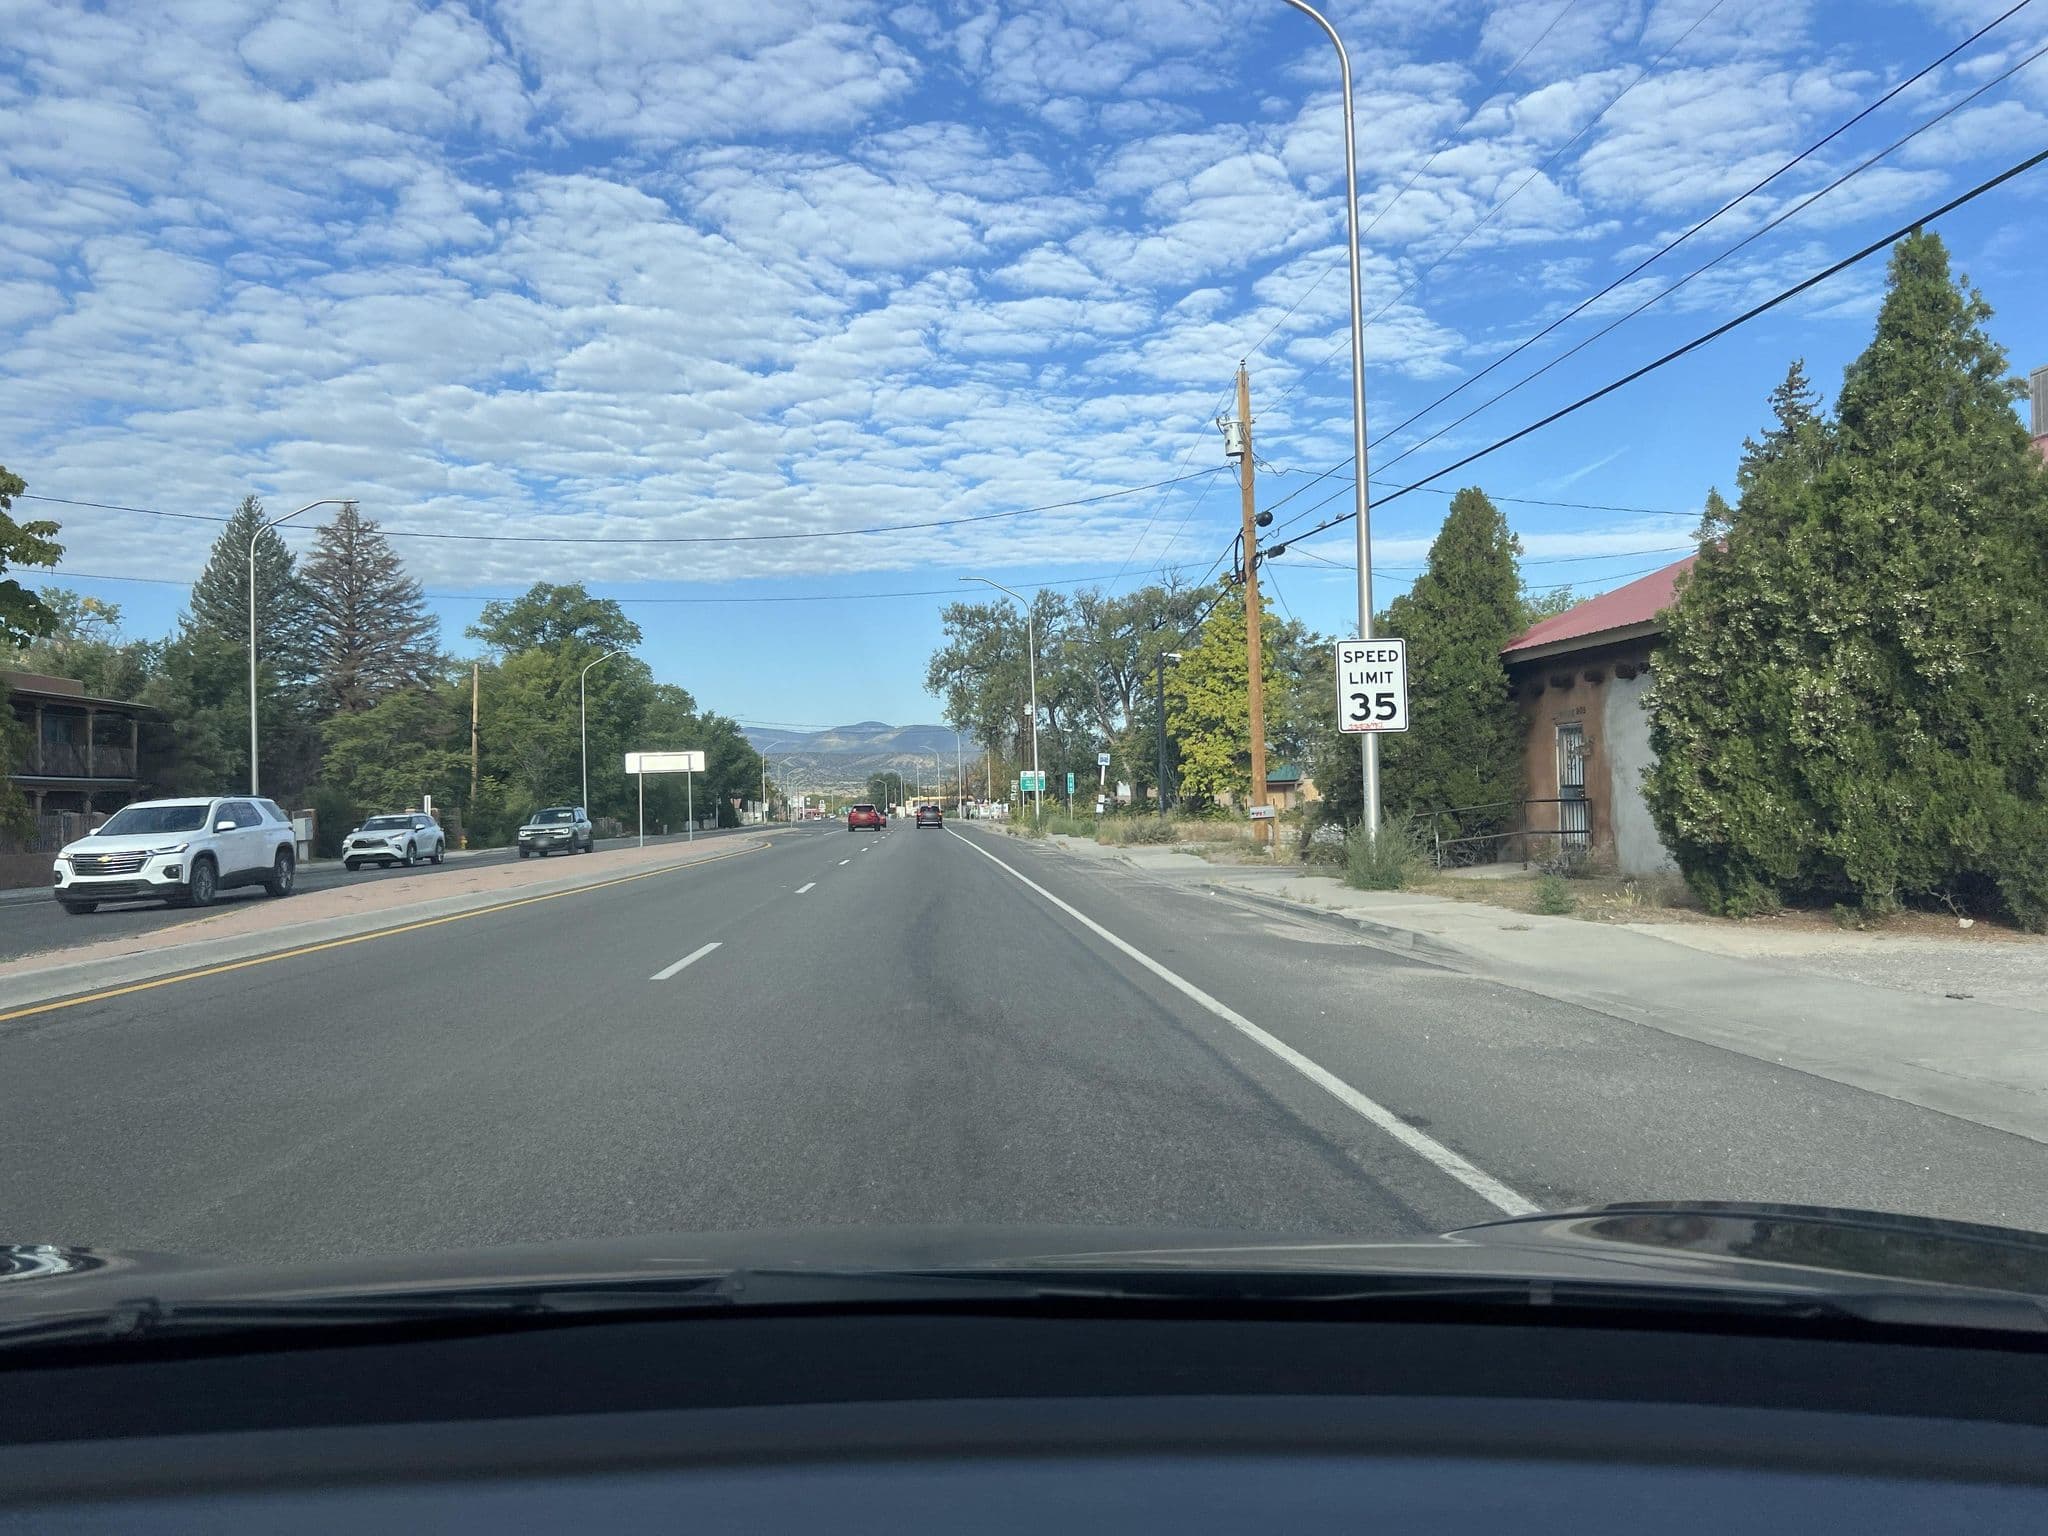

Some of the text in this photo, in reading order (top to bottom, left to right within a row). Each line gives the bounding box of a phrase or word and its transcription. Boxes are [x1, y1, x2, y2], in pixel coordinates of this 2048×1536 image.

[1343, 650, 1399, 663] SPEED
[1349, 671, 1394, 685] LIMIT
[1349, 692, 1397, 721] 35
